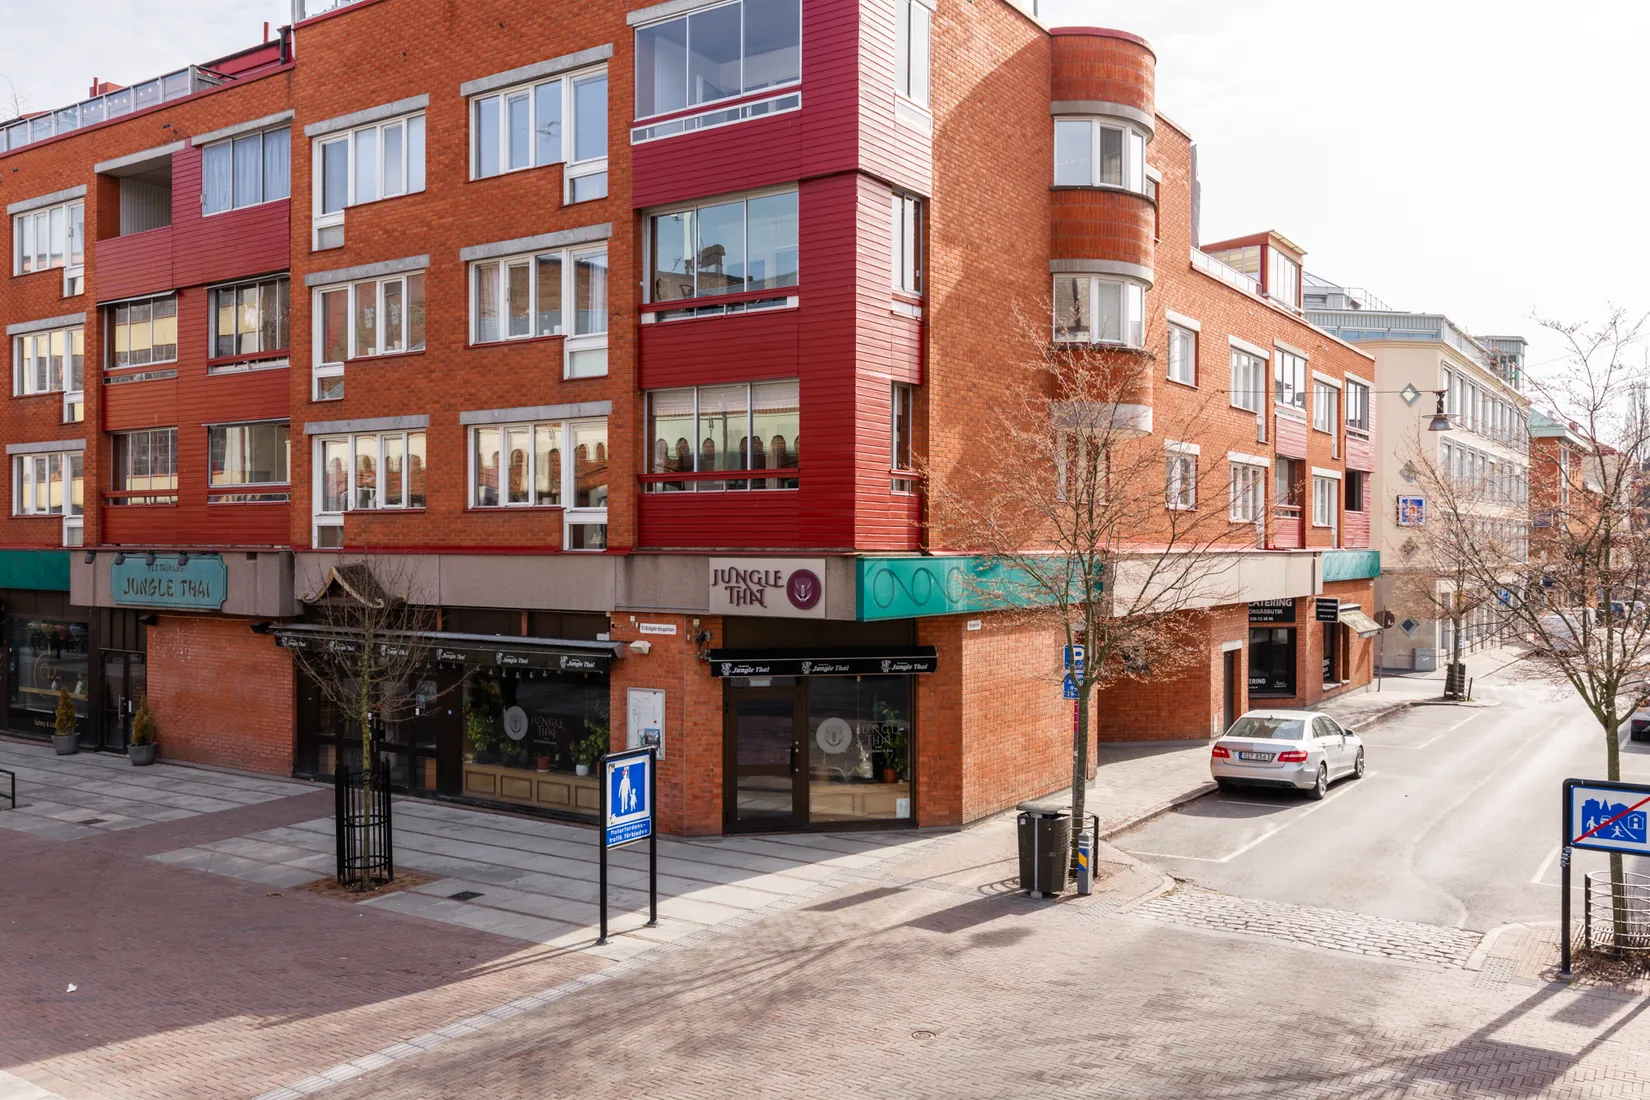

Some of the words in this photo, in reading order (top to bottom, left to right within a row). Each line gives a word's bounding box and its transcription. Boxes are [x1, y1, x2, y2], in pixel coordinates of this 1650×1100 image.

[711, 566, 785, 588] JUNGLE
[123, 577, 174, 597] JUNGLE
[179, 579, 210, 598] THAI
[724, 585, 767, 608] THAI
[1248, 598, 1292, 607] CATERING
[502, 656, 518, 664] Jungle
[566, 660, 584, 668] Jungle
[731, 666, 755, 674] Jungle
[812, 664, 834, 672] Jungle
[891, 663, 913, 671] Jungle
[610, 823, 646, 836] Motorfordons-
[608, 834, 623, 843] trafik
[623, 829, 648, 839] förbjuden
